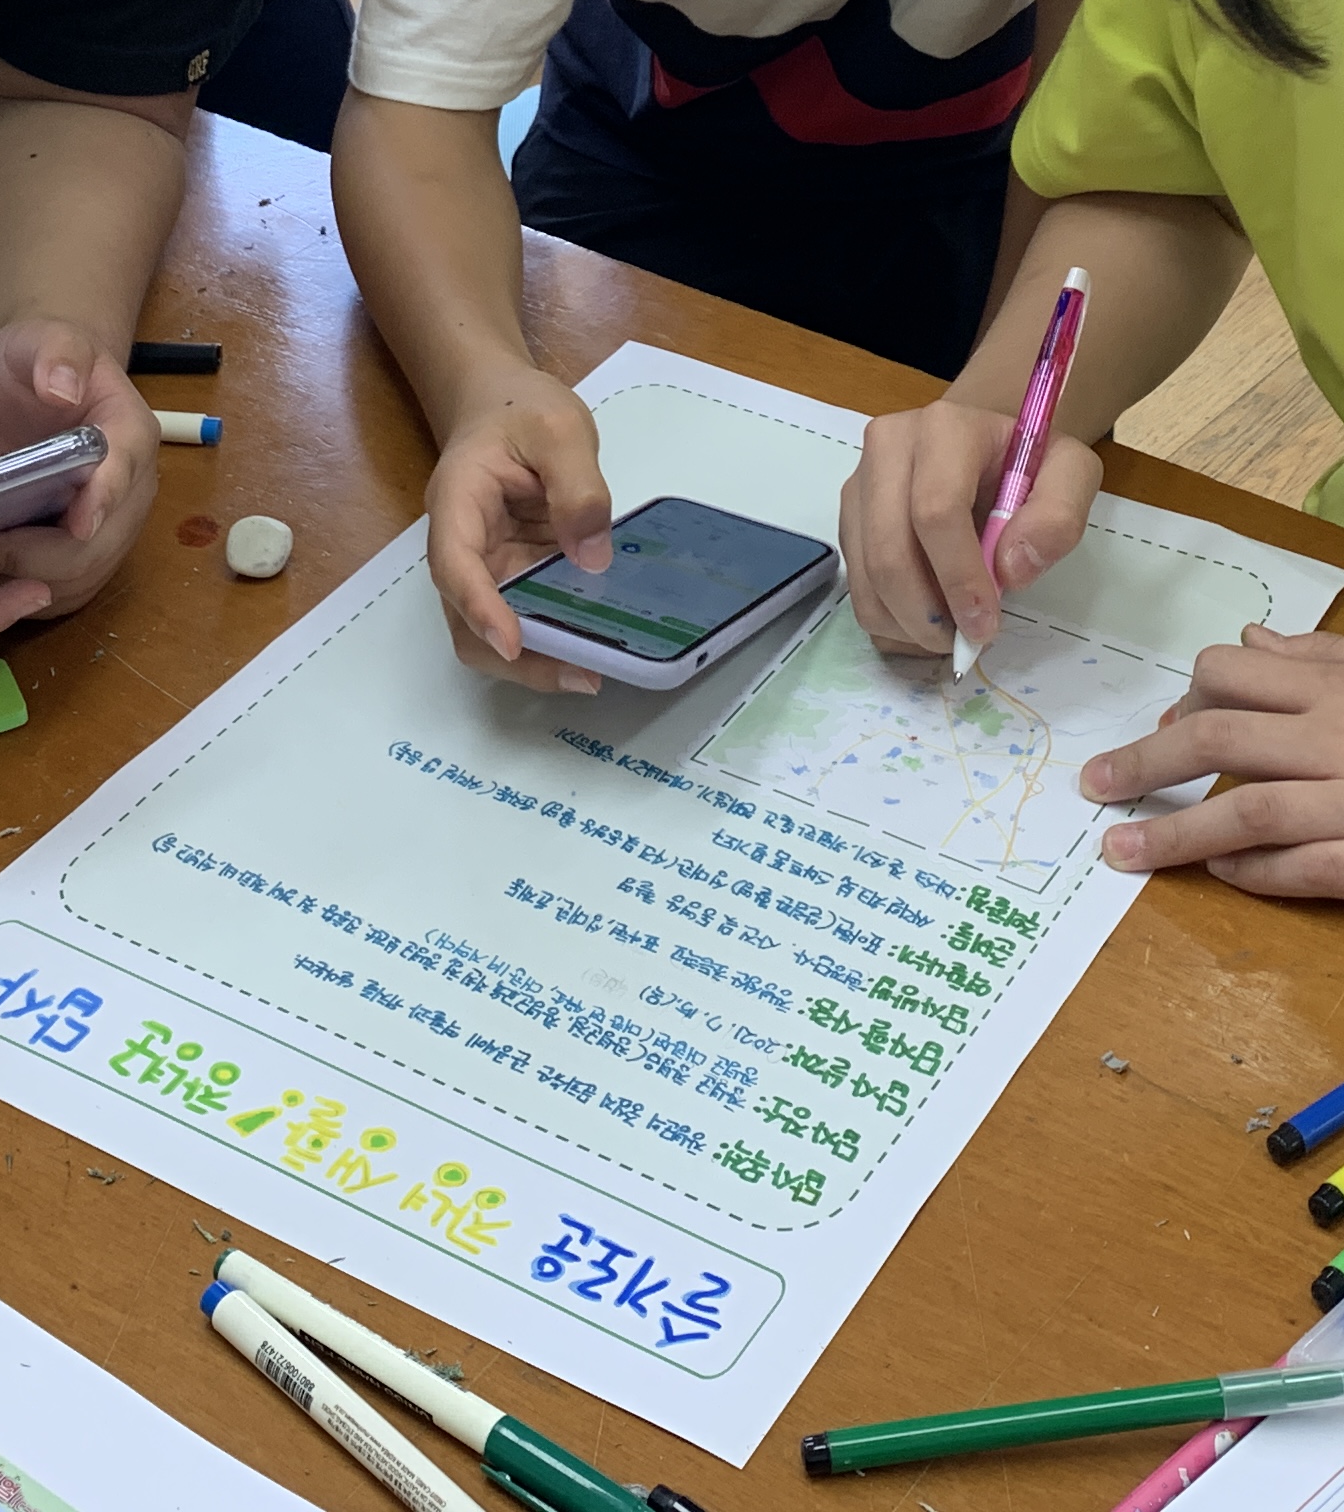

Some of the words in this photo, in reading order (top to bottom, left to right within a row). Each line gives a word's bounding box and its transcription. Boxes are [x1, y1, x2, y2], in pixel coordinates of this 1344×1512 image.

[665, 894, 717, 928] 동영상
[737, 924, 781, 950] 사진
[939, 920, 1016, 968] 준비물:
[886, 944, 992, 997] 역할나누기:
[108, 1019, 241, 1115] 창녕군
[225, 1088, 398, 1194] 생활!
[398, 1161, 512, 1255] 창녕
[530, 1214, 730, 1347] 슬기로운
